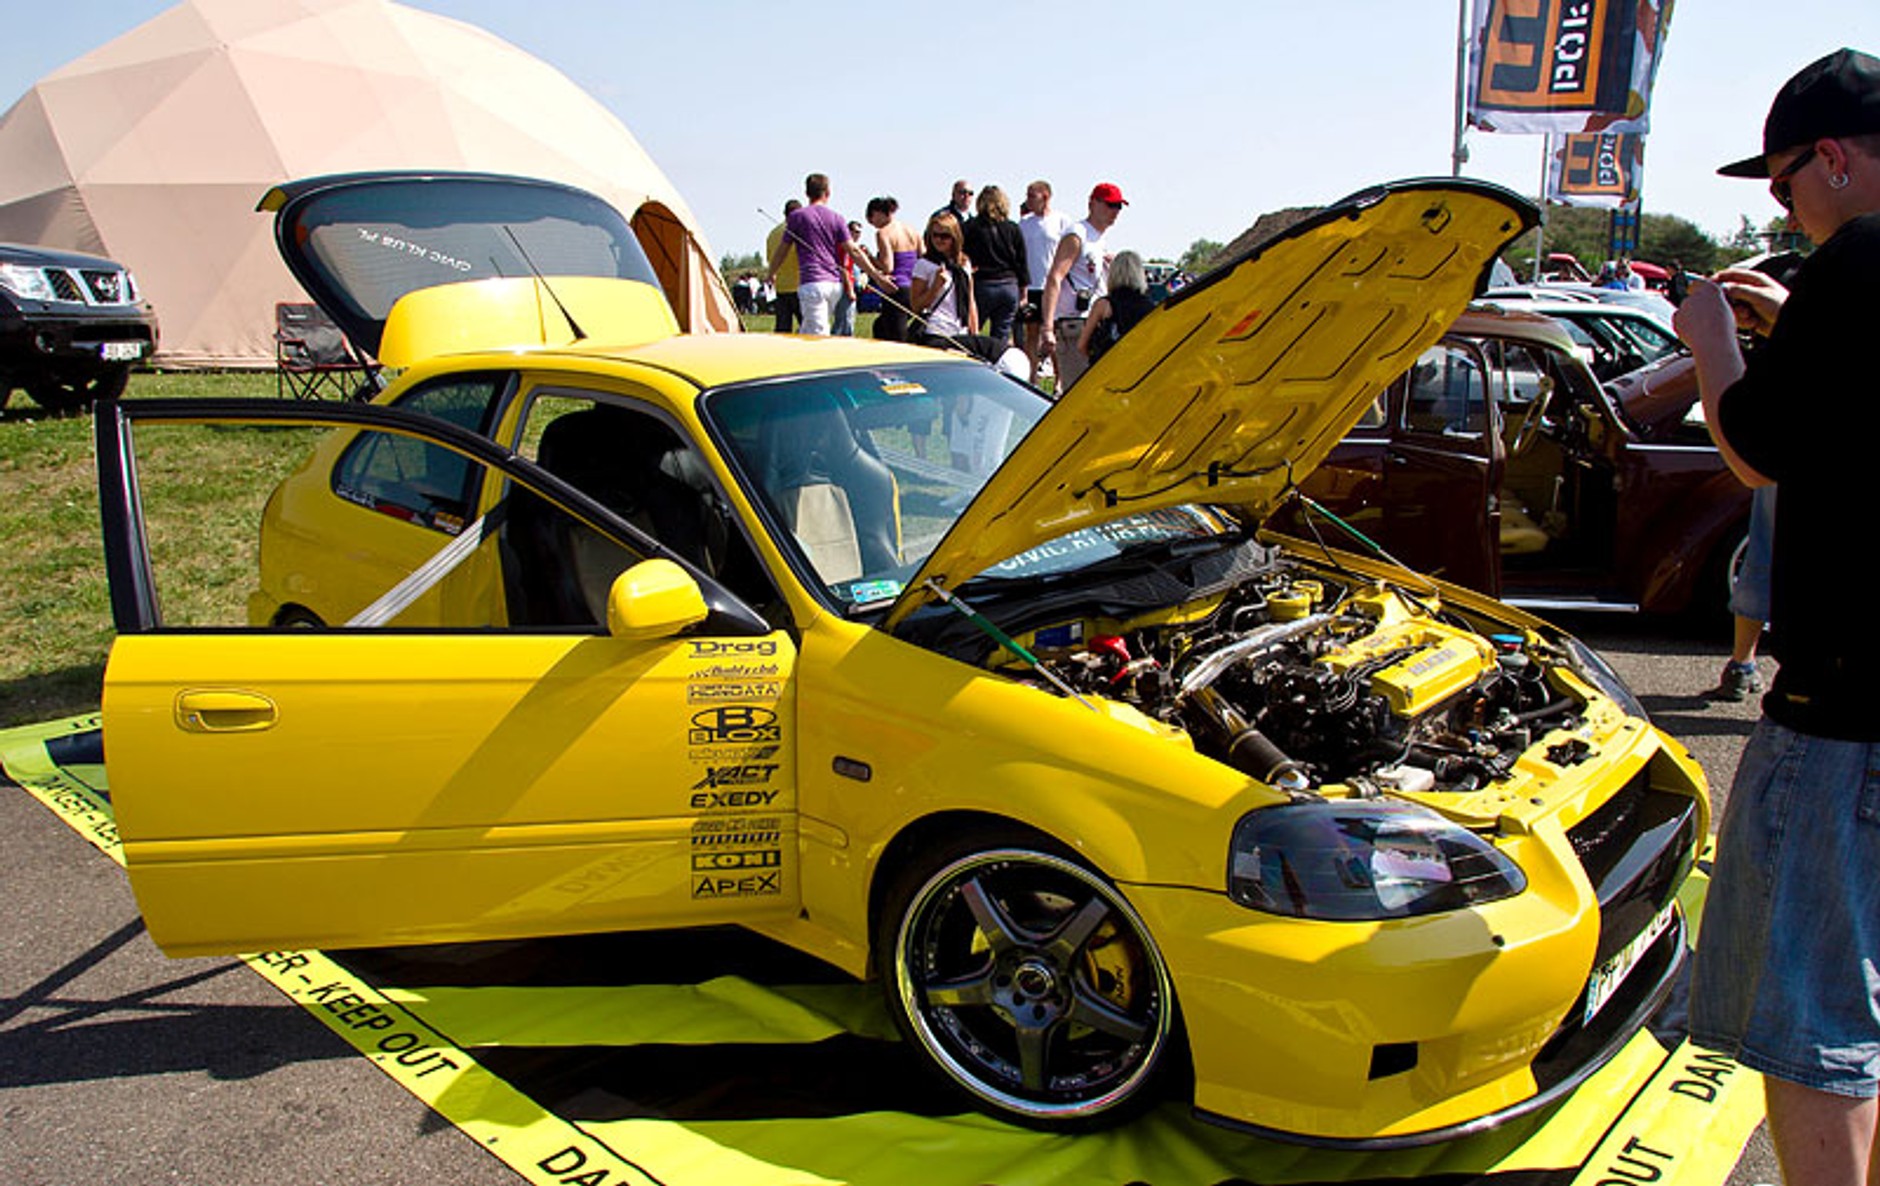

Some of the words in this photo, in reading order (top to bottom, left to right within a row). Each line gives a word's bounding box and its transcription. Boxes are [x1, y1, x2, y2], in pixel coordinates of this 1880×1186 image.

[429, 251, 472, 272] CIVIC
[688, 641, 777, 656] Drag
[690, 727, 780, 743] BLOX
[690, 790, 779, 808] EXEDY
[694, 852, 776, 869] KONI
[307, 981, 396, 1030] KEEP
[378, 1033, 459, 1077] OUT
[1594, 1136, 1674, 1186] UT
